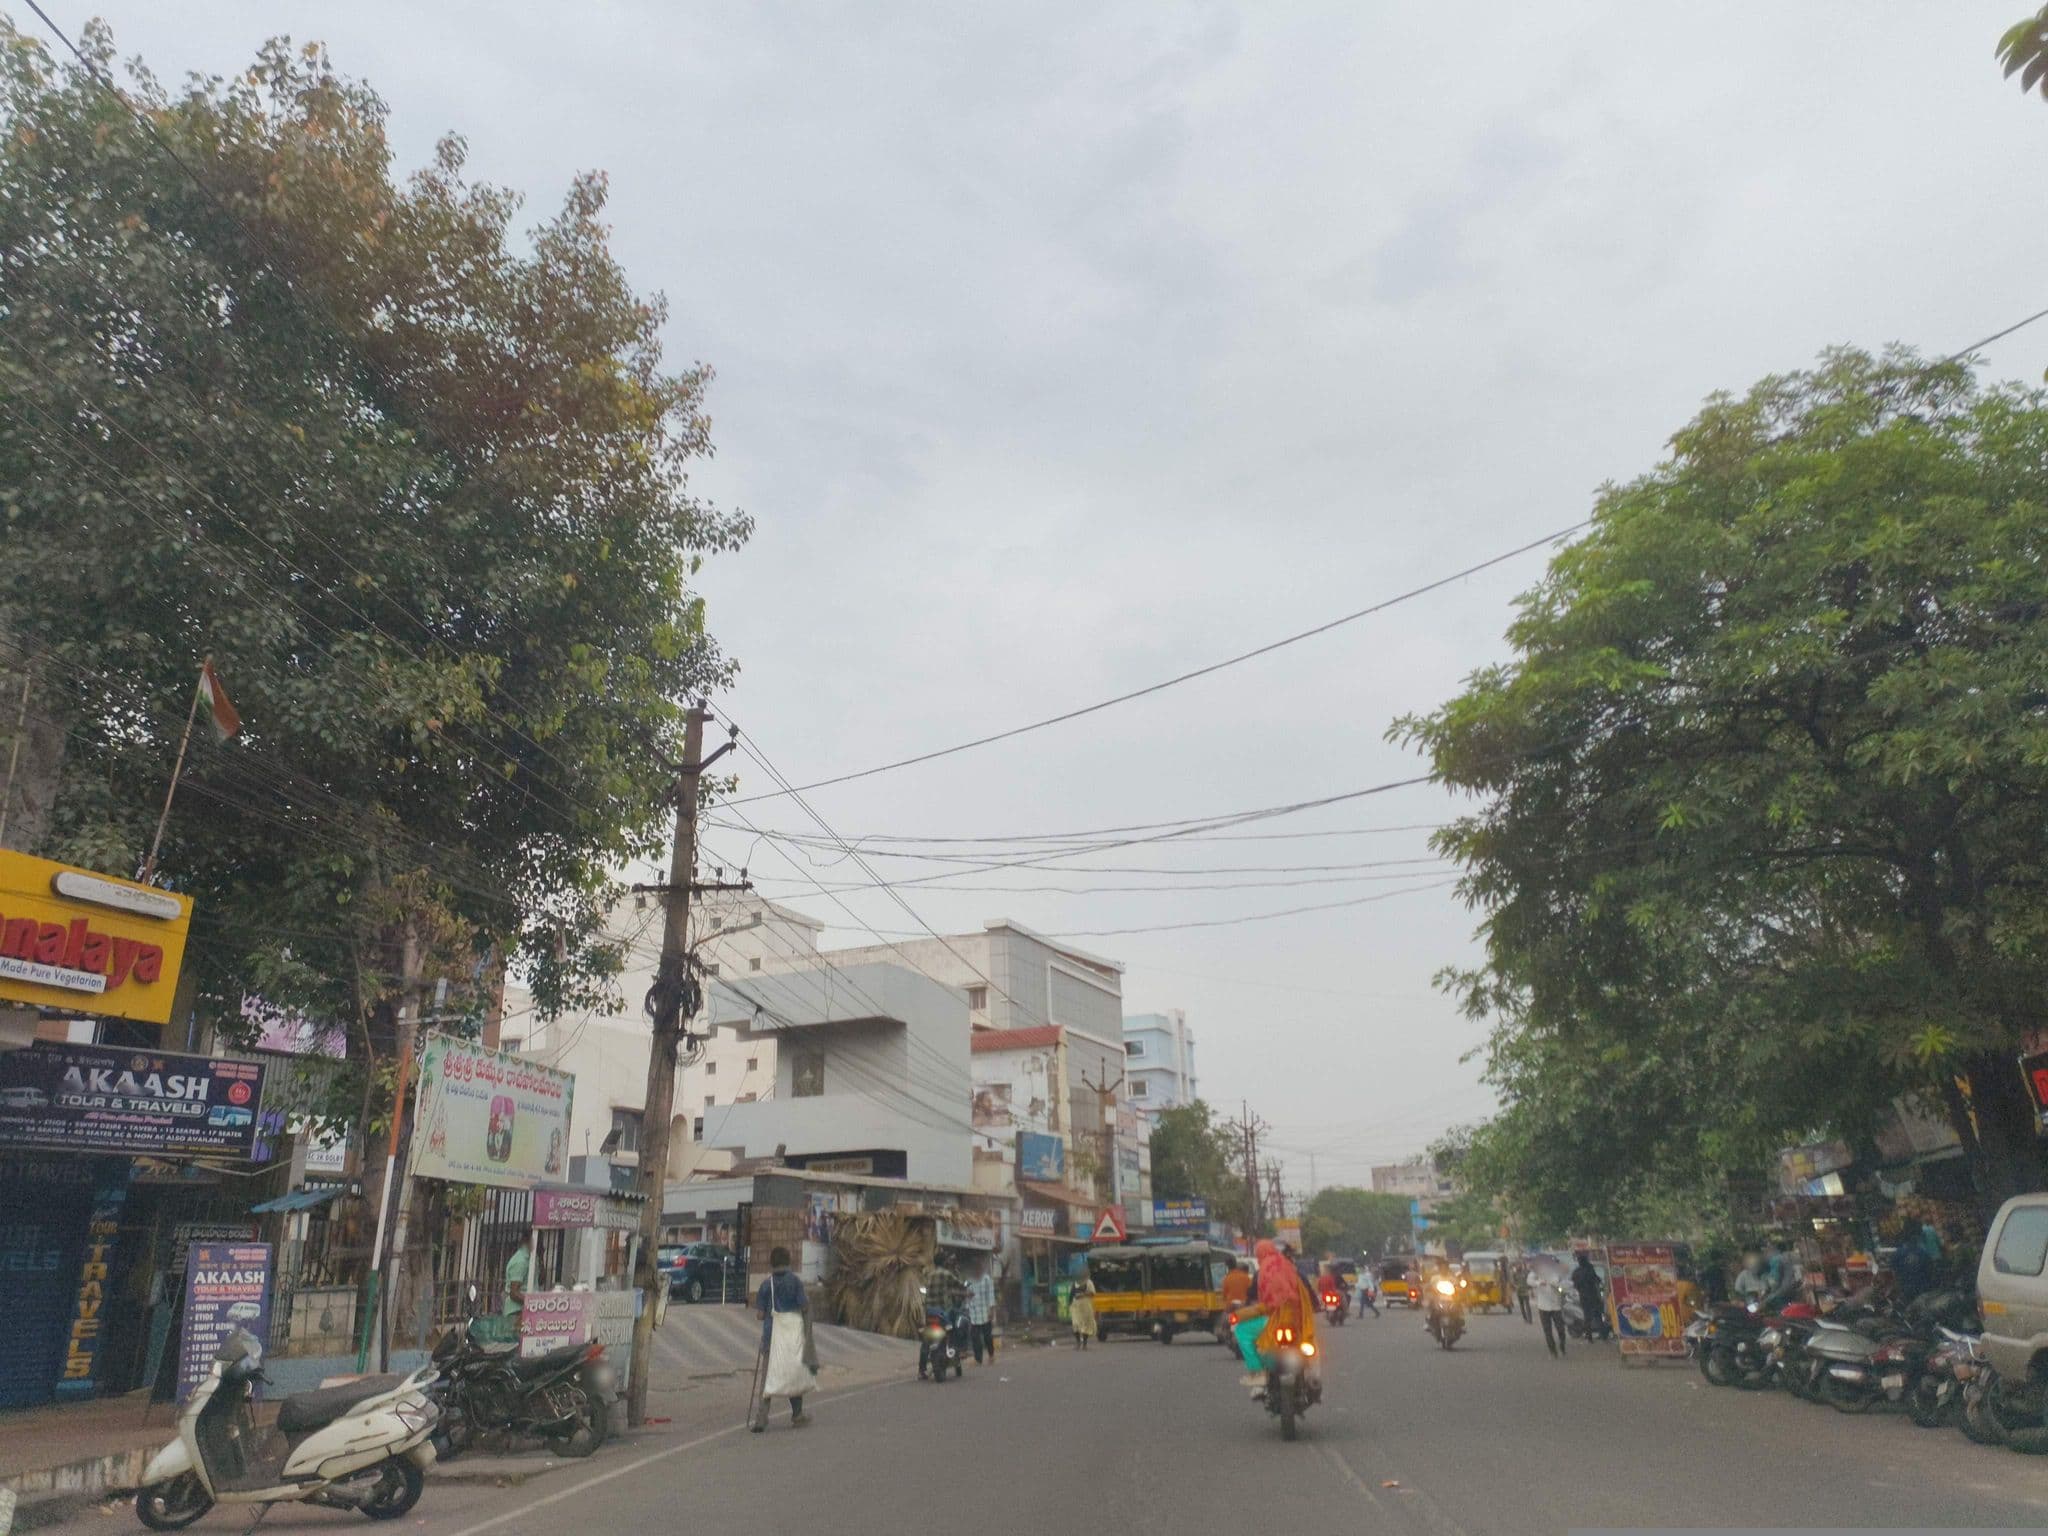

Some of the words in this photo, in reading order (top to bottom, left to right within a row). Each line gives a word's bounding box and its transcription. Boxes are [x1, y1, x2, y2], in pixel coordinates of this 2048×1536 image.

[0, 912, 164, 991] nalaya
[1, 961, 28, 976] Made
[30, 966, 52, 979] Pure
[54, 971, 103, 989] Vegetarian
[63, 1066, 210, 1100] AKAASH
[61, 1095, 106, 1109] TOUR
[111, 1098, 124, 1109] &
[129, 1099, 204, 1116] TRAVELS
[37, 1126, 66, 1135] SEATER
[86, 1129, 112, 1138] SEATER
[134, 1132, 153, 1141] NON
[155, 1133, 165, 1141] AC
[166, 1134, 186, 1143] ALSO
[187, 1135, 226, 1145] AVAILABLE
[129, 1125, 158, 1134] TAVERA
[175, 1128, 201, 1136] SEATER
[1022, 1209, 1055, 1228] XEROX
[194, 1271, 265, 1284] AKAASH
[64, 1244, 113, 1378] TRAVELS
[195, 1303, 219, 1311] INNOVA
[194, 1323, 214, 1331] SWIFT
[193, 1333, 218, 1341] TAVERA
[191, 1354, 200, 1362] 17
[190, 1364, 199, 1372] 24
[189, 1375, 198, 1383] 40
